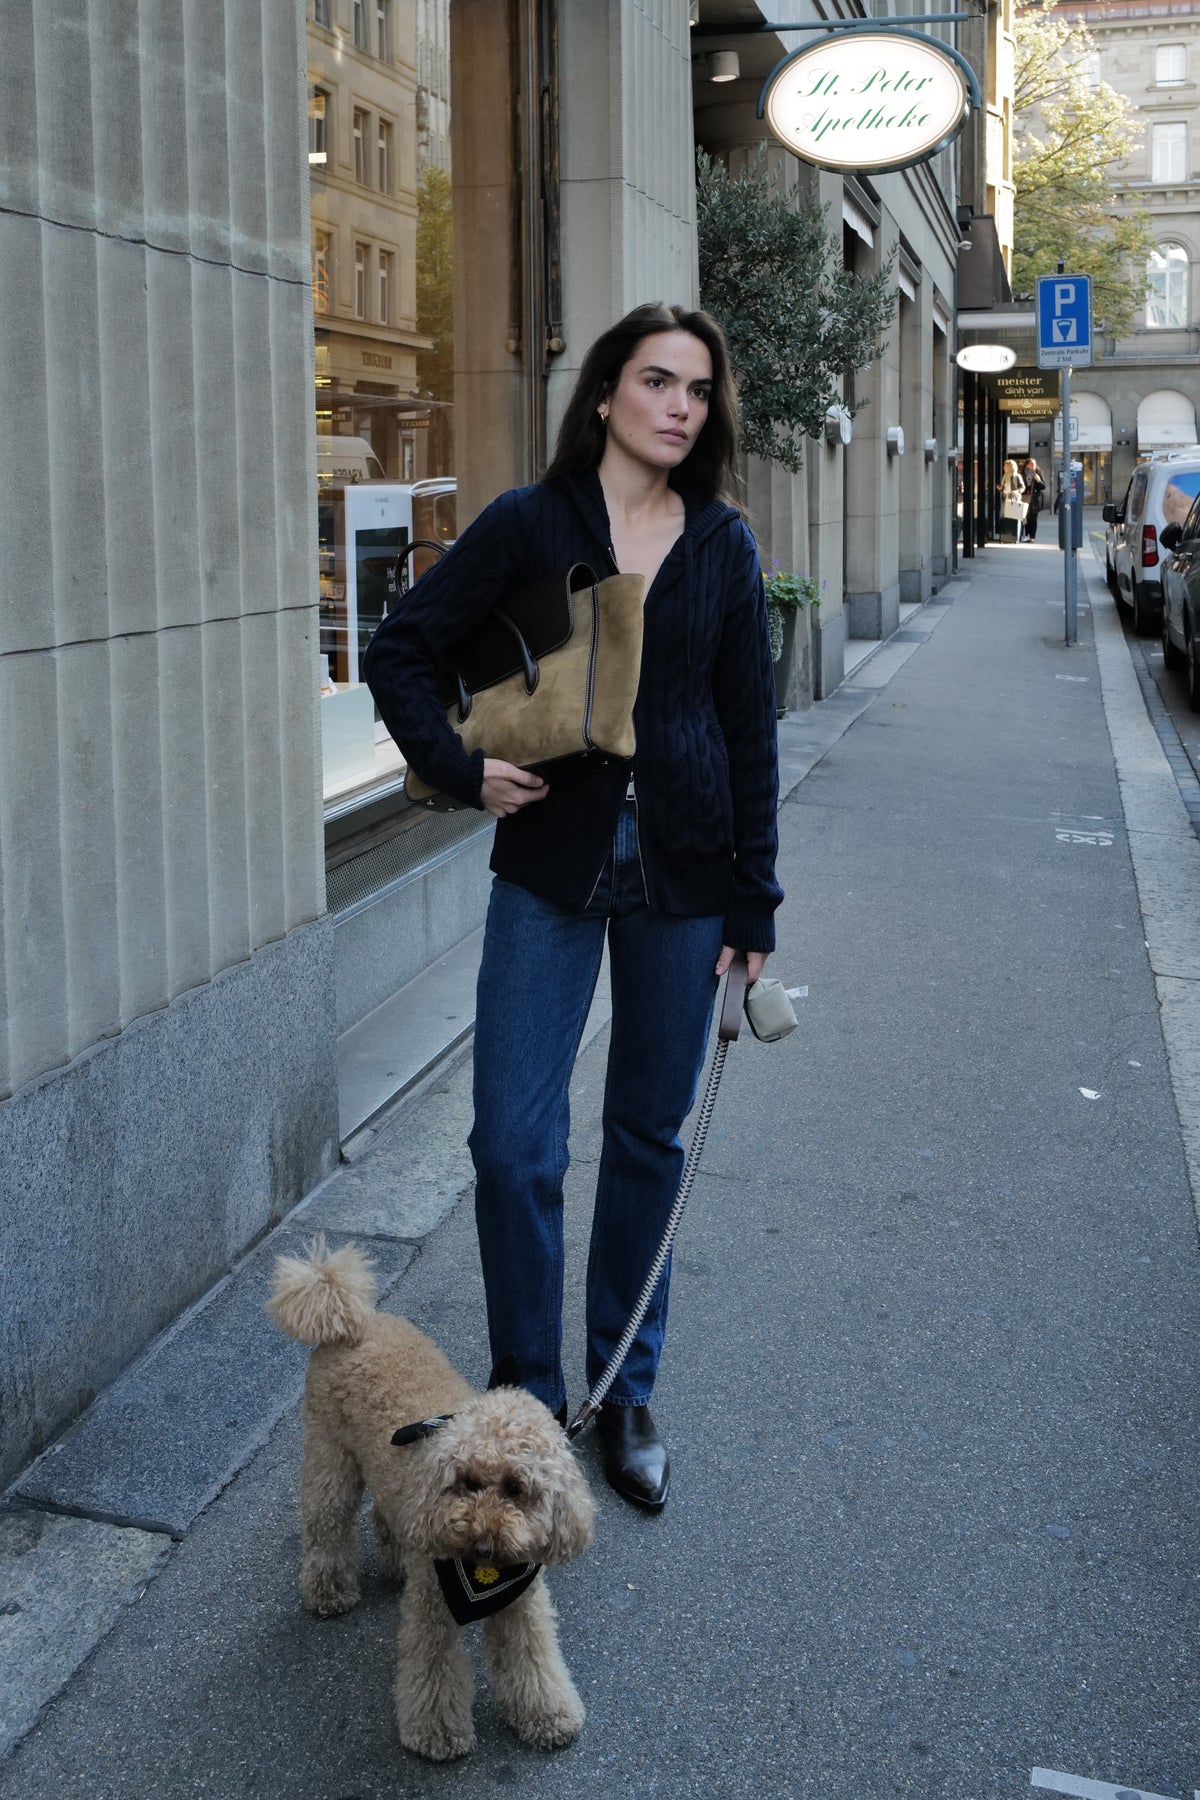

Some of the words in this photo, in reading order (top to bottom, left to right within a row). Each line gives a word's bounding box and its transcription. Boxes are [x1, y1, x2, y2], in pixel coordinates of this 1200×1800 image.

[797, 68, 839, 97] St.
[851, 66, 933, 93] Peter
[795, 103, 932, 141] Apotheke
[1055, 283, 1075, 317] P
[1066, 347, 1089, 355] Parkuhr
[997, 377, 1042, 386] meister
[1057, 423, 1075, 432] TXI
